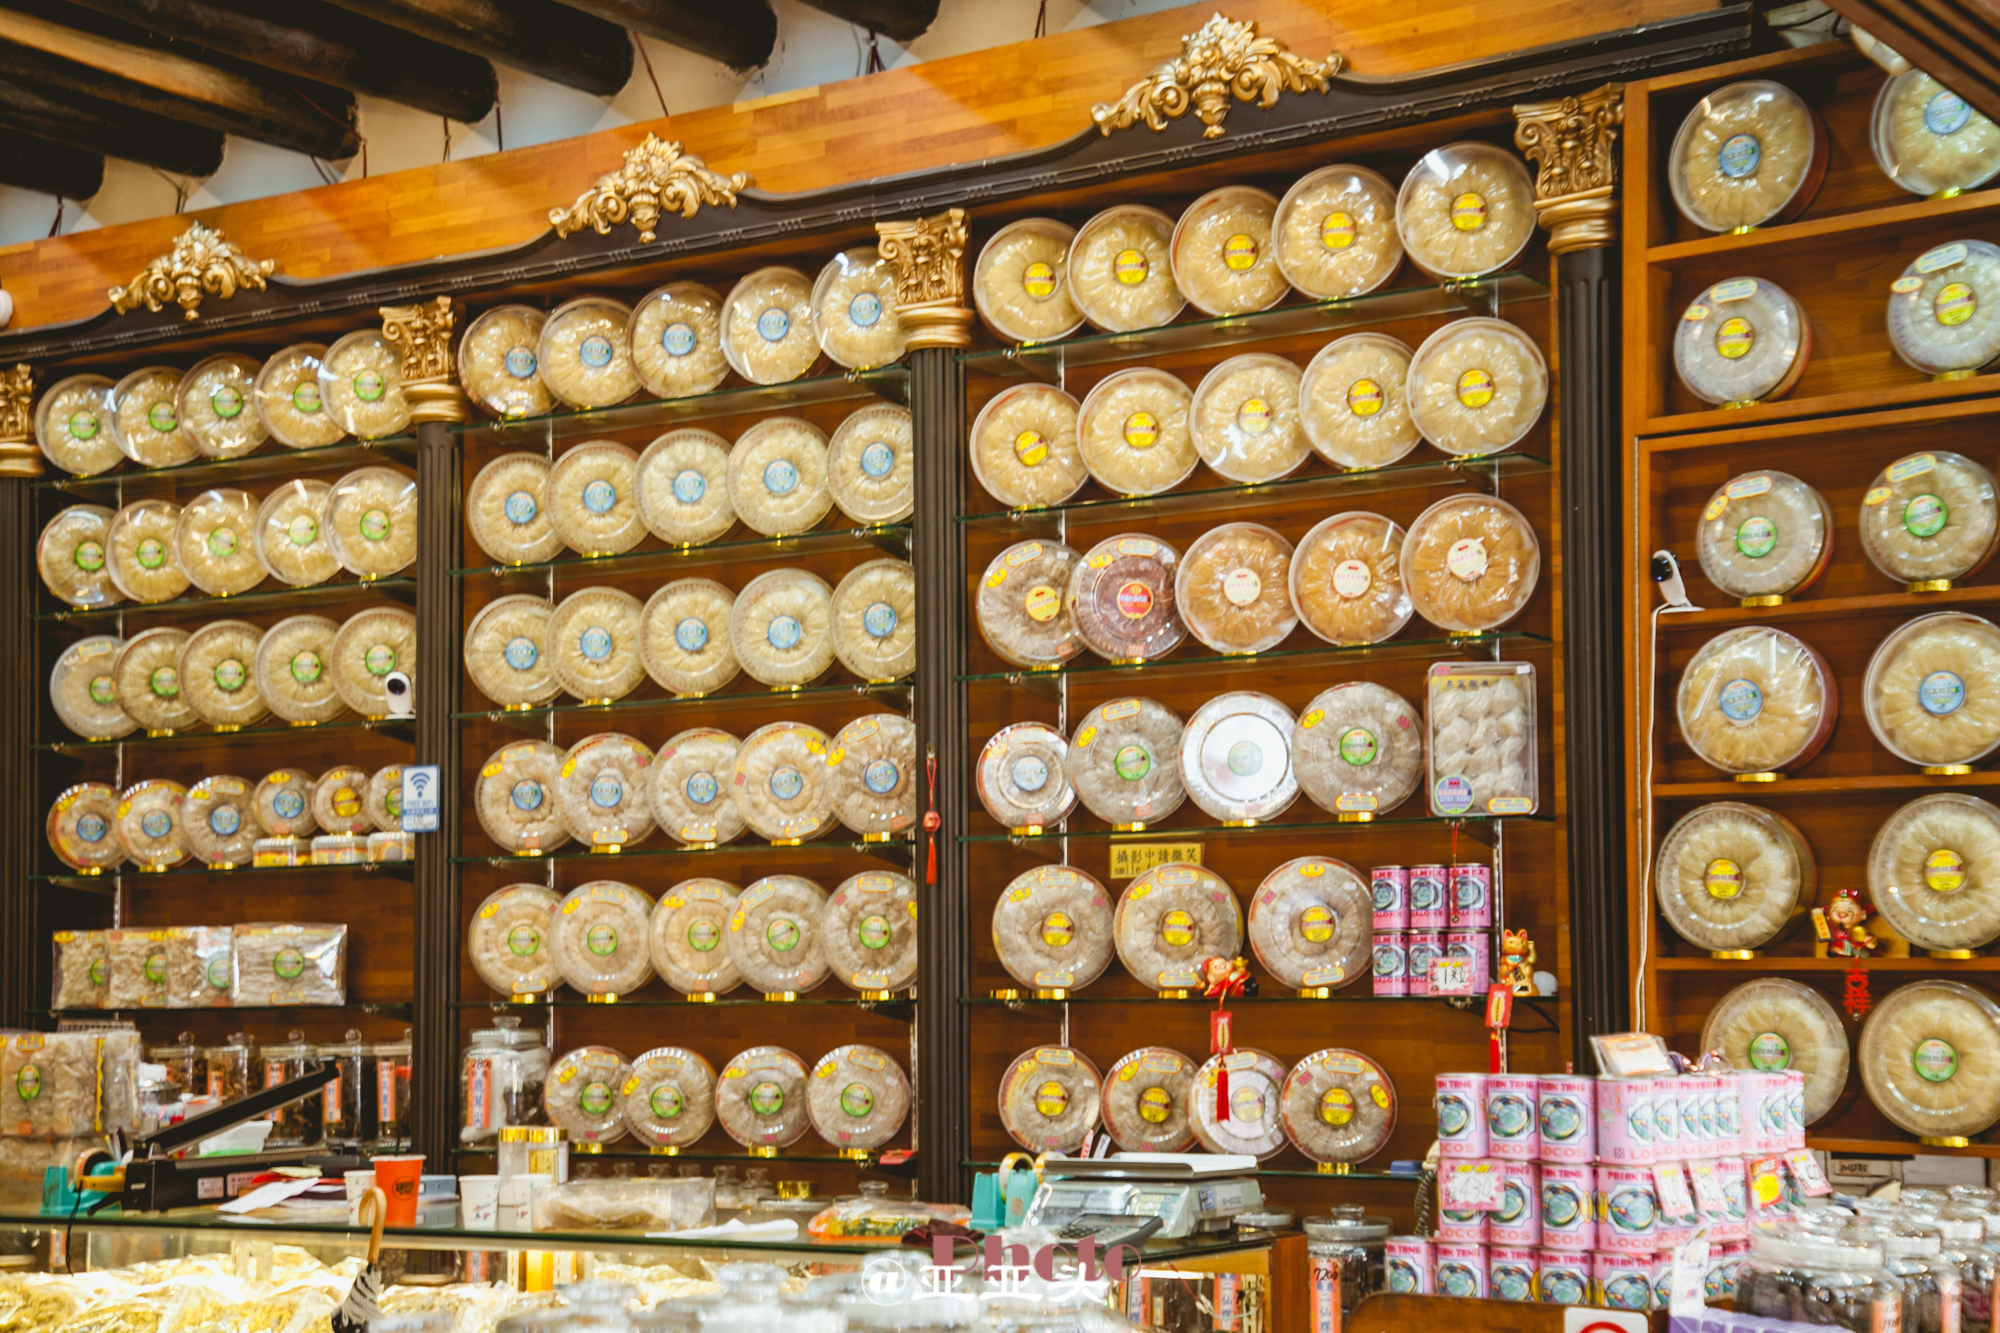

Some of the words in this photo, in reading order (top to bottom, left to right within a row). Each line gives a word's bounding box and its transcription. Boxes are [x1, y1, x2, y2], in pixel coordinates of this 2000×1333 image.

[1117, 848, 1198, 864] 攝影中請微笑
[1844, 969, 1872, 1015] 吉祥
[474, 1079, 486, 1128] 鹿茸尖
[1459, 1176, 1492, 1200] 430
